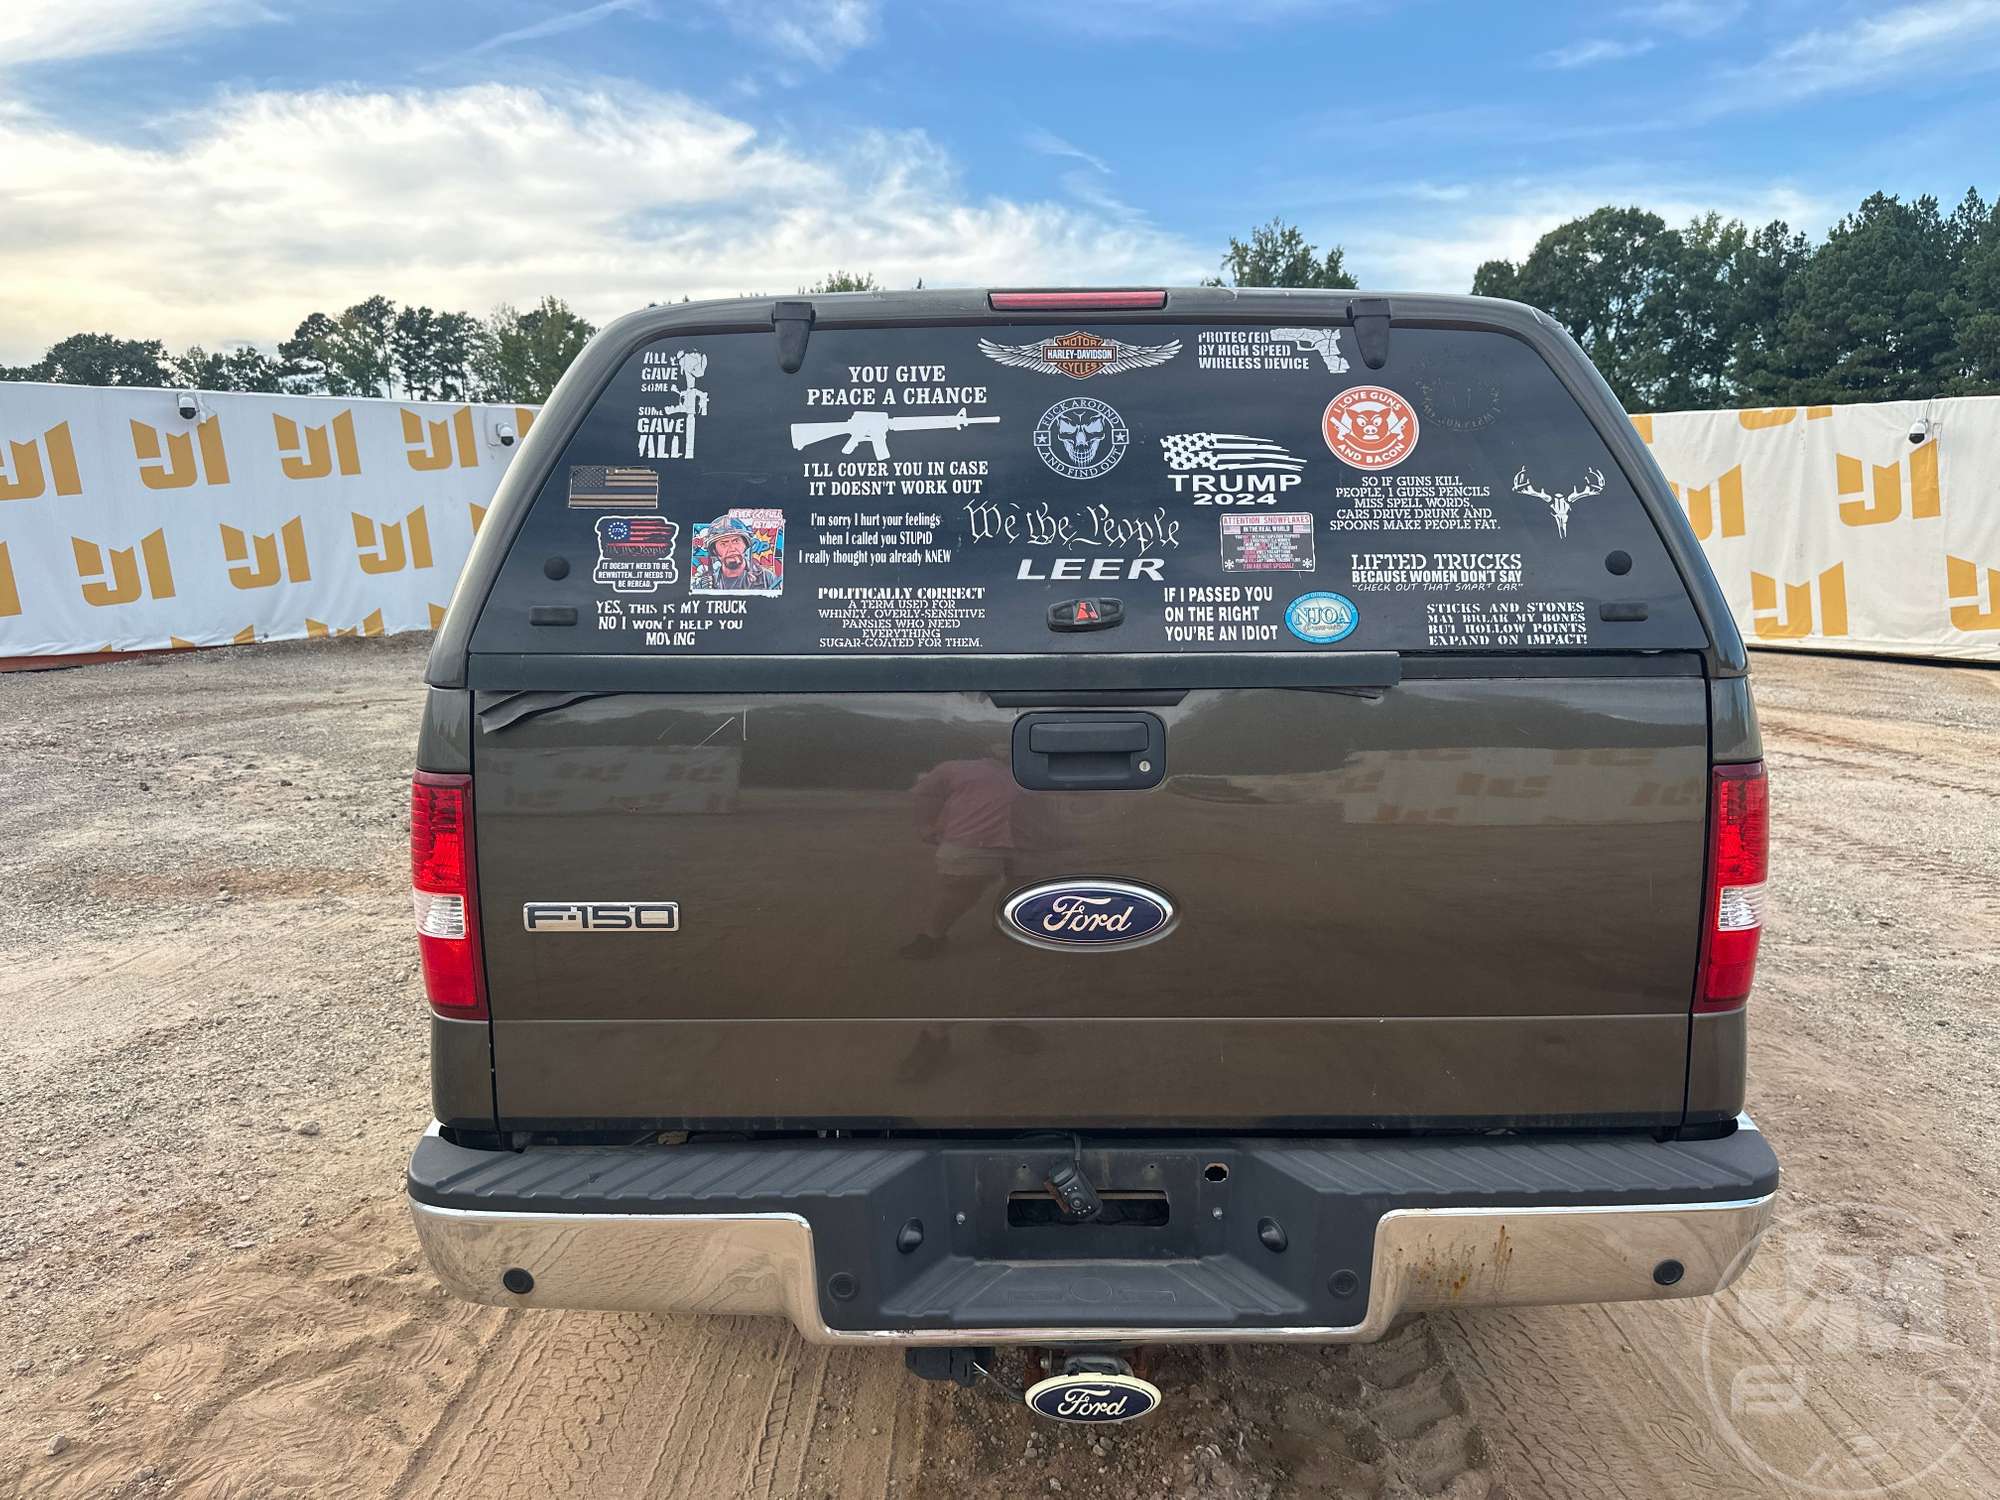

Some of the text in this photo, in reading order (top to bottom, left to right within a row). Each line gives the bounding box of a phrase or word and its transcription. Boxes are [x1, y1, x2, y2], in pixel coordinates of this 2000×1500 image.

[1063, 336, 1097, 346] MOTOR
[1198, 332, 1269, 344] PROTECTED
[1048, 350, 1112, 359] HARLEY-DAVIDSON
[1198, 345, 1290, 356] BY HIGH SPEED
[643, 352, 668, 364] ALL
[1198, 357, 1310, 369] WIRELESS DEVICE
[641, 368, 678, 380] GAVE
[849, 365, 946, 383] YOU GIVE
[1062, 362, 1097, 374] CYCLES
[641, 383, 668, 392] SOME
[807, 387, 987, 405] PEACE A CHANCE
[1338, 392, 1402, 410] LOVE GUNS
[1042, 400, 1119, 426] FUCK AROUND
[637, 418, 685, 433] GAVE
[638, 435, 682, 458] ALL
[1337, 442, 1405, 463] AND BACON
[804, 460, 988, 477] I'LL COVER YOU IN CASE
[1042, 448, 1120, 478] AND FIND OUT
[1168, 474, 1302, 492] TRUMP
[1362, 476, 1462, 486] SO IF GUNS KILL
[810, 480, 982, 496] IT DOESN'T WORK OUT
[1336, 488, 1490, 499] PEOPLE, I GUESS PENCILS
[1193, 493, 1278, 506] 2024
[1354, 498, 1474, 509] MISS SPELL WORDS,
[811, 512, 940, 528] I'm sorry I hurt your feelings
[1224, 516, 1310, 524] ATTENTION SNOWFLAKES
[1336, 508, 1492, 519] CARS DRIVE DRUNK AND
[1330, 520, 1500, 531] SPOONS MAKE PEOPLE FAT.
[820, 532, 932, 547] when I called you STUPID
[799, 550, 952, 566] I really thought you already KNEW
[1352, 554, 1522, 570] LIFTED TRUCKS
[1016, 558, 1164, 581] LEER
[1352, 571, 1522, 582] BECAUSE WOMEN DON'T SAY
[818, 588, 986, 600] POLITICALLY CORRECT
[1164, 586, 1272, 602] IF I PASSED YOU
[596, 601, 747, 614] YES, THIS IS MY TRUCK
[848, 600, 956, 609] A TERM USED FOR
[1426, 602, 1585, 613] STICKS AND STONES
[874, 609, 986, 618] OVERLY-SENSITIVE
[1165, 606, 1260, 622] ON THE RIGHT
[1294, 607, 1352, 625] NJOA
[1428, 613, 1586, 624] MAY BREAK MY BONES
[599, 616, 743, 630] NO I WON'T HELP YOU
[842, 619, 960, 628] PANSIES WHO NEED
[1428, 623, 1586, 634] BUT HOLLOW POINTS
[646, 632, 695, 646] MOVING
[862, 628, 941, 638] EVERYTHING
[1165, 625, 1278, 642] YOU'RE AN IDIOT
[820, 638, 982, 648] SUGAR-COATED FOR THEM.
[1429, 634, 1588, 646] EXPAND ON IMPACT!
[528, 905, 674, 928] F-150
[1043, 896, 1134, 932] Ford
[1057, 1388, 1128, 1417] Ford
